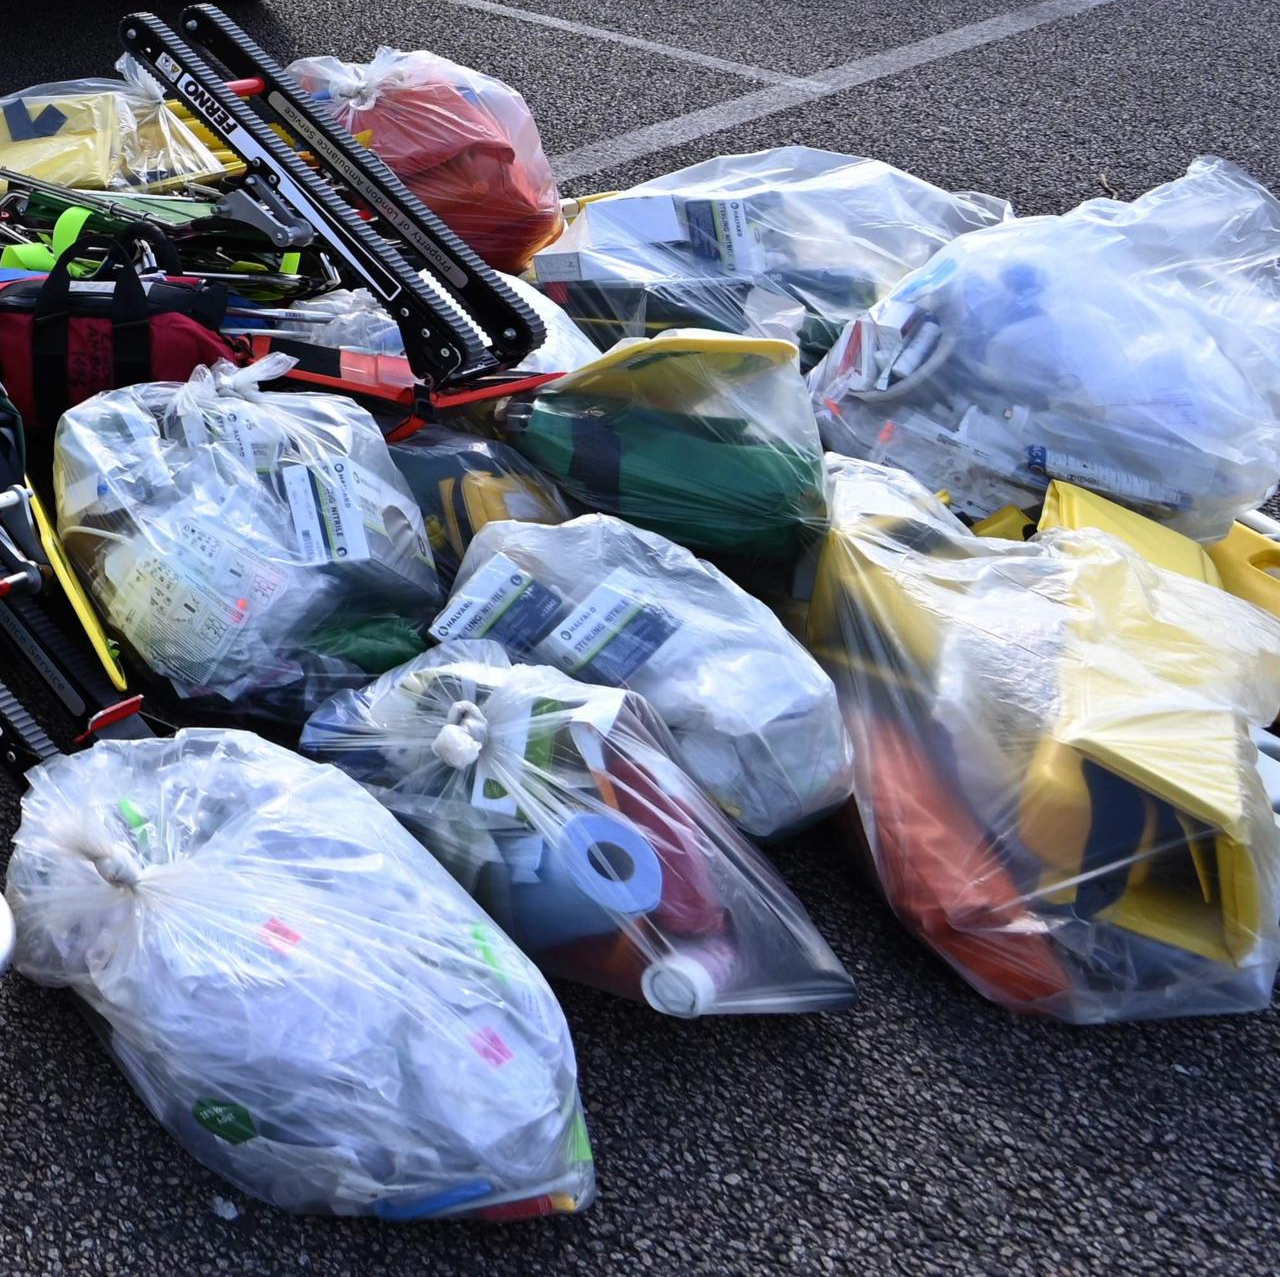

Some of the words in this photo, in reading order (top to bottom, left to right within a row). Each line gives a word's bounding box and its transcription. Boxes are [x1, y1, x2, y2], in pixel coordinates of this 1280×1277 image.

[182, 79, 238, 136] FERNO
[283, 105, 316, 141] Service
[316, 136, 365, 188] Ambulance
[365, 185, 399, 222] London
[402, 219, 419, 236] of
[419, 237, 452, 273] Property
[569, 606, 597, 634] HALYAD
[574, 622, 606, 653] STERLING
[604, 599, 630, 625] NITRILE
[29, 642, 66, 691] Service
